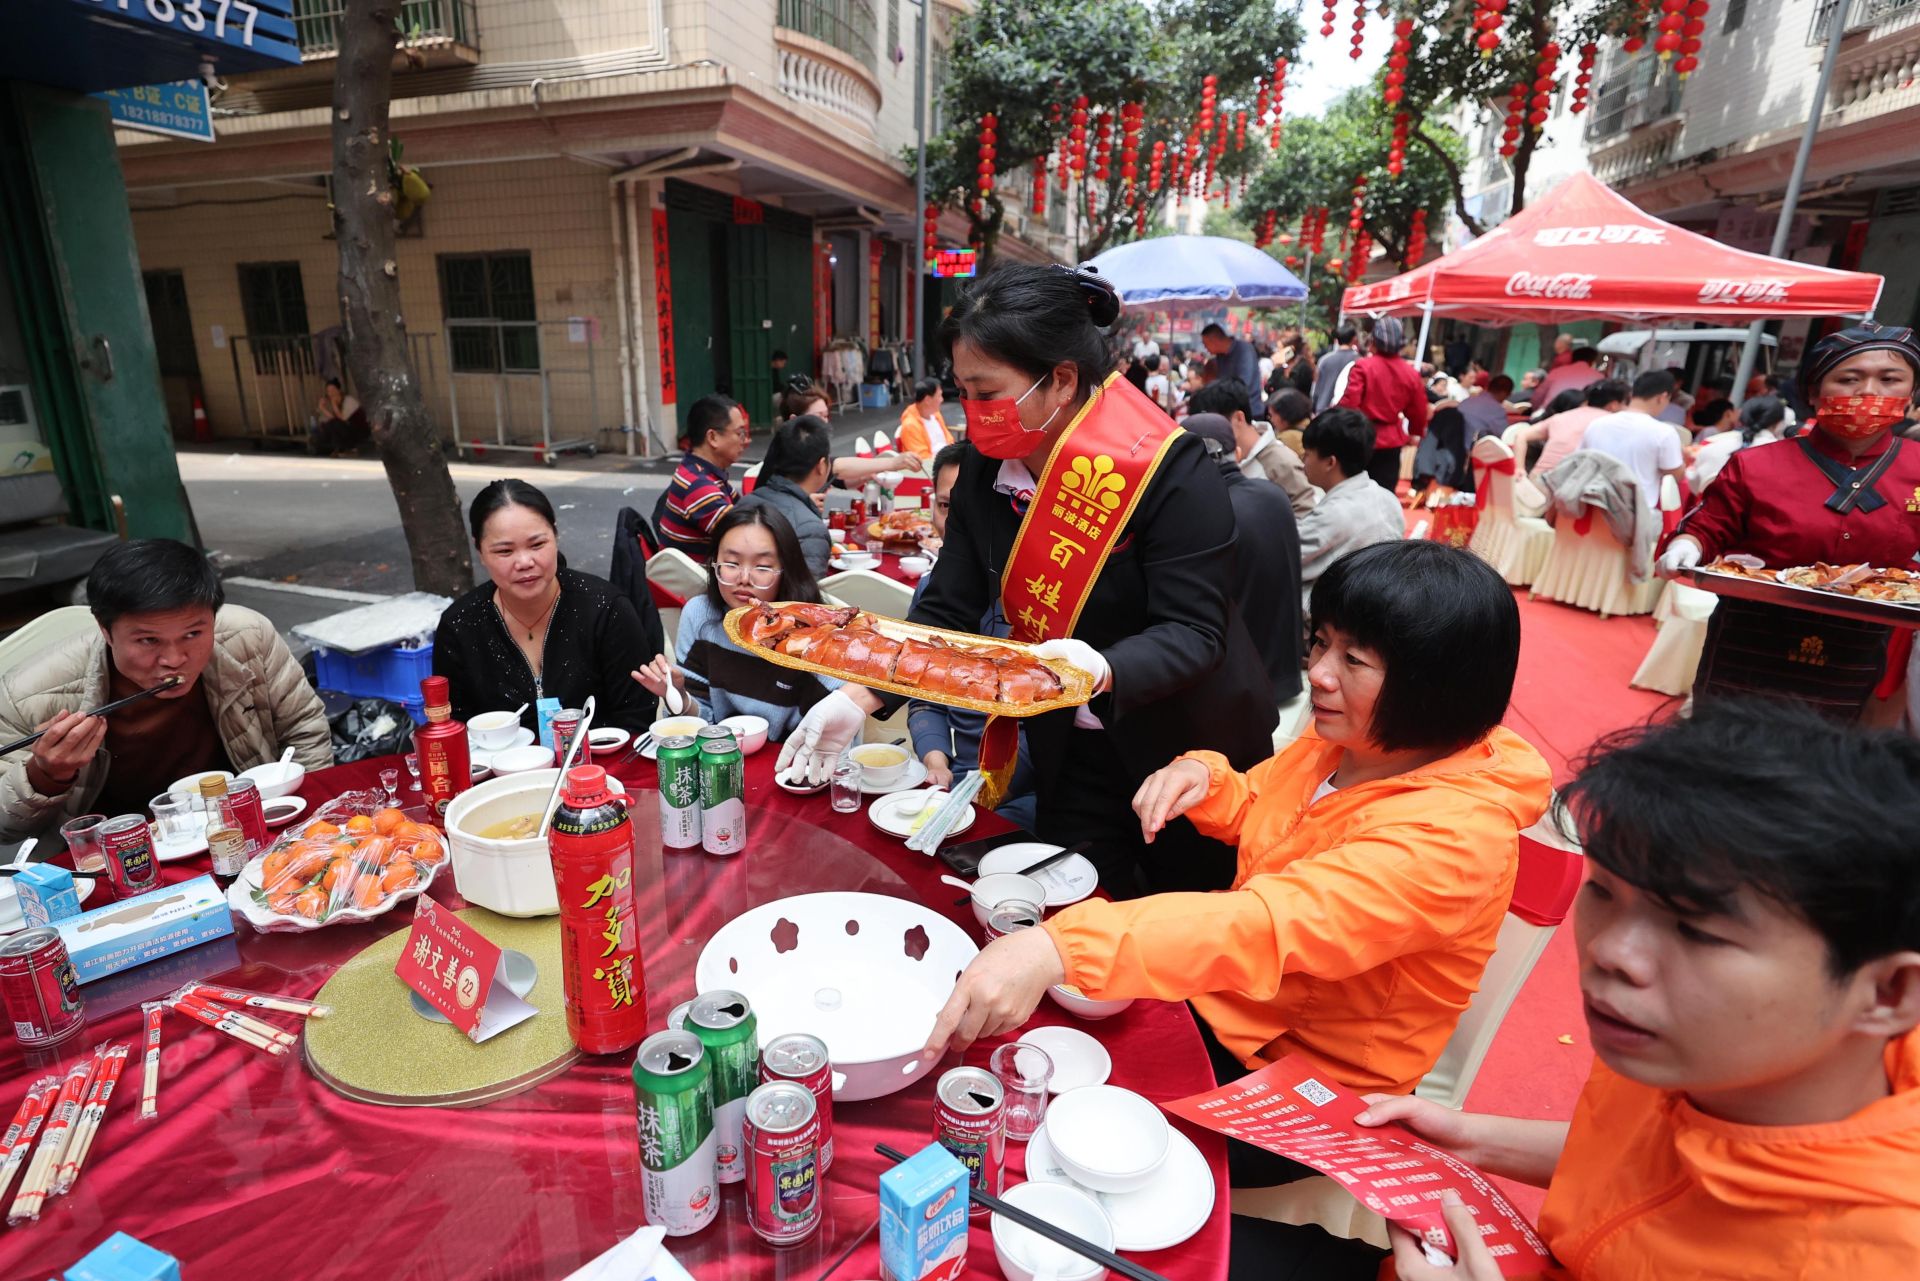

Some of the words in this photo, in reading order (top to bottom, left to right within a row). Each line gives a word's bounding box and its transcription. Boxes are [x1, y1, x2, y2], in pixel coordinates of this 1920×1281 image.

[1533, 224, 1668, 247] 可口可乐
[1697, 278, 1798, 304] 可口可乐
[1051, 503, 1102, 541] 丽波酒店
[675, 766, 693, 805] 抹茶
[413, 933, 460, 990] 谢文善
[461, 978, 474, 998] 22
[638, 1101, 665, 1168] 抹茶
